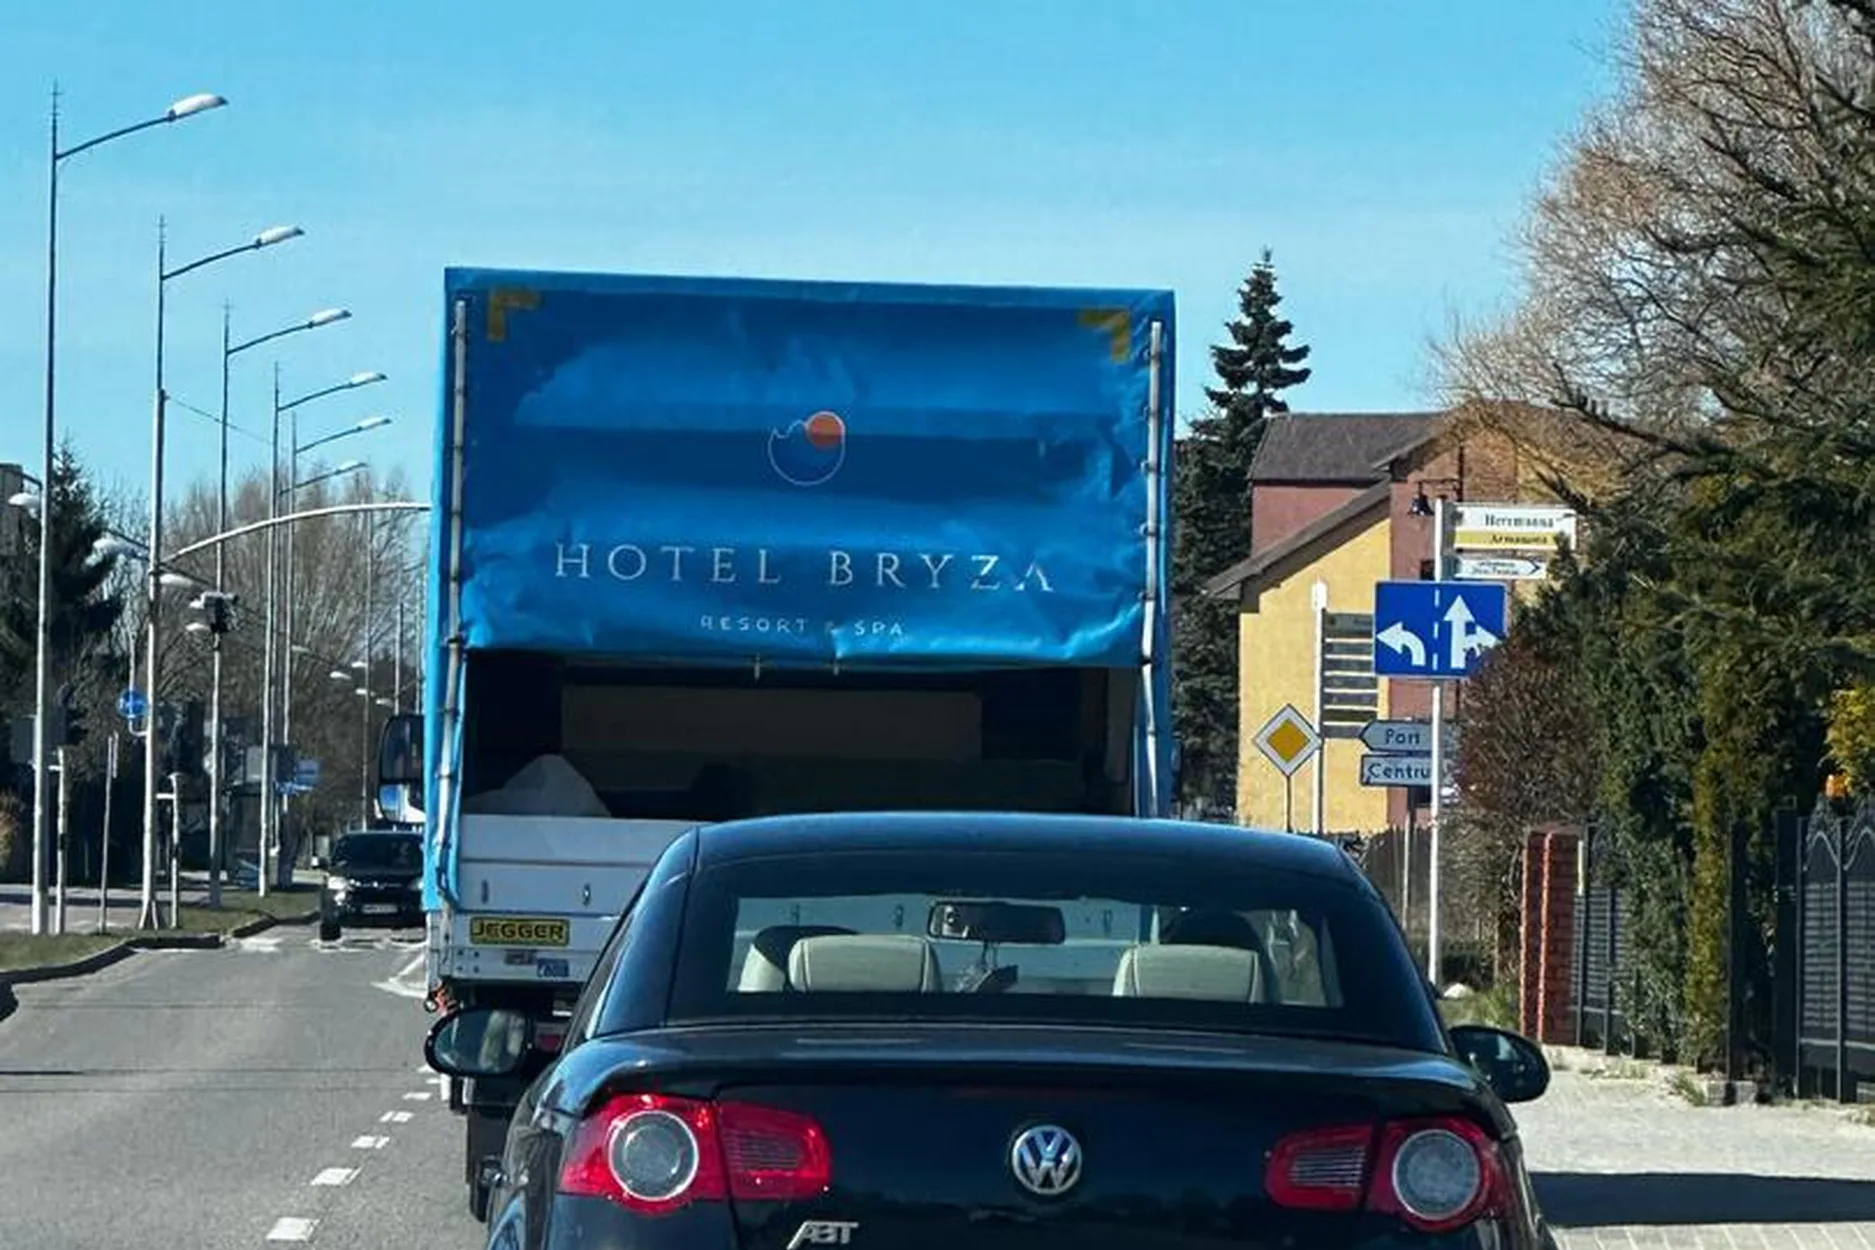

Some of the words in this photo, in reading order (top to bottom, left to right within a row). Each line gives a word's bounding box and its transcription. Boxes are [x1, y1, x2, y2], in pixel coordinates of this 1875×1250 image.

[555, 542, 782, 584] HOTEL
[829, 551, 1054, 593] BRYZA
[700, 614, 810, 634] RESORT
[853, 619, 904, 637] SPA
[1384, 728, 1421, 745] Port
[1367, 762, 1433, 779] Centru
[786, 1220, 860, 1250] ABT
